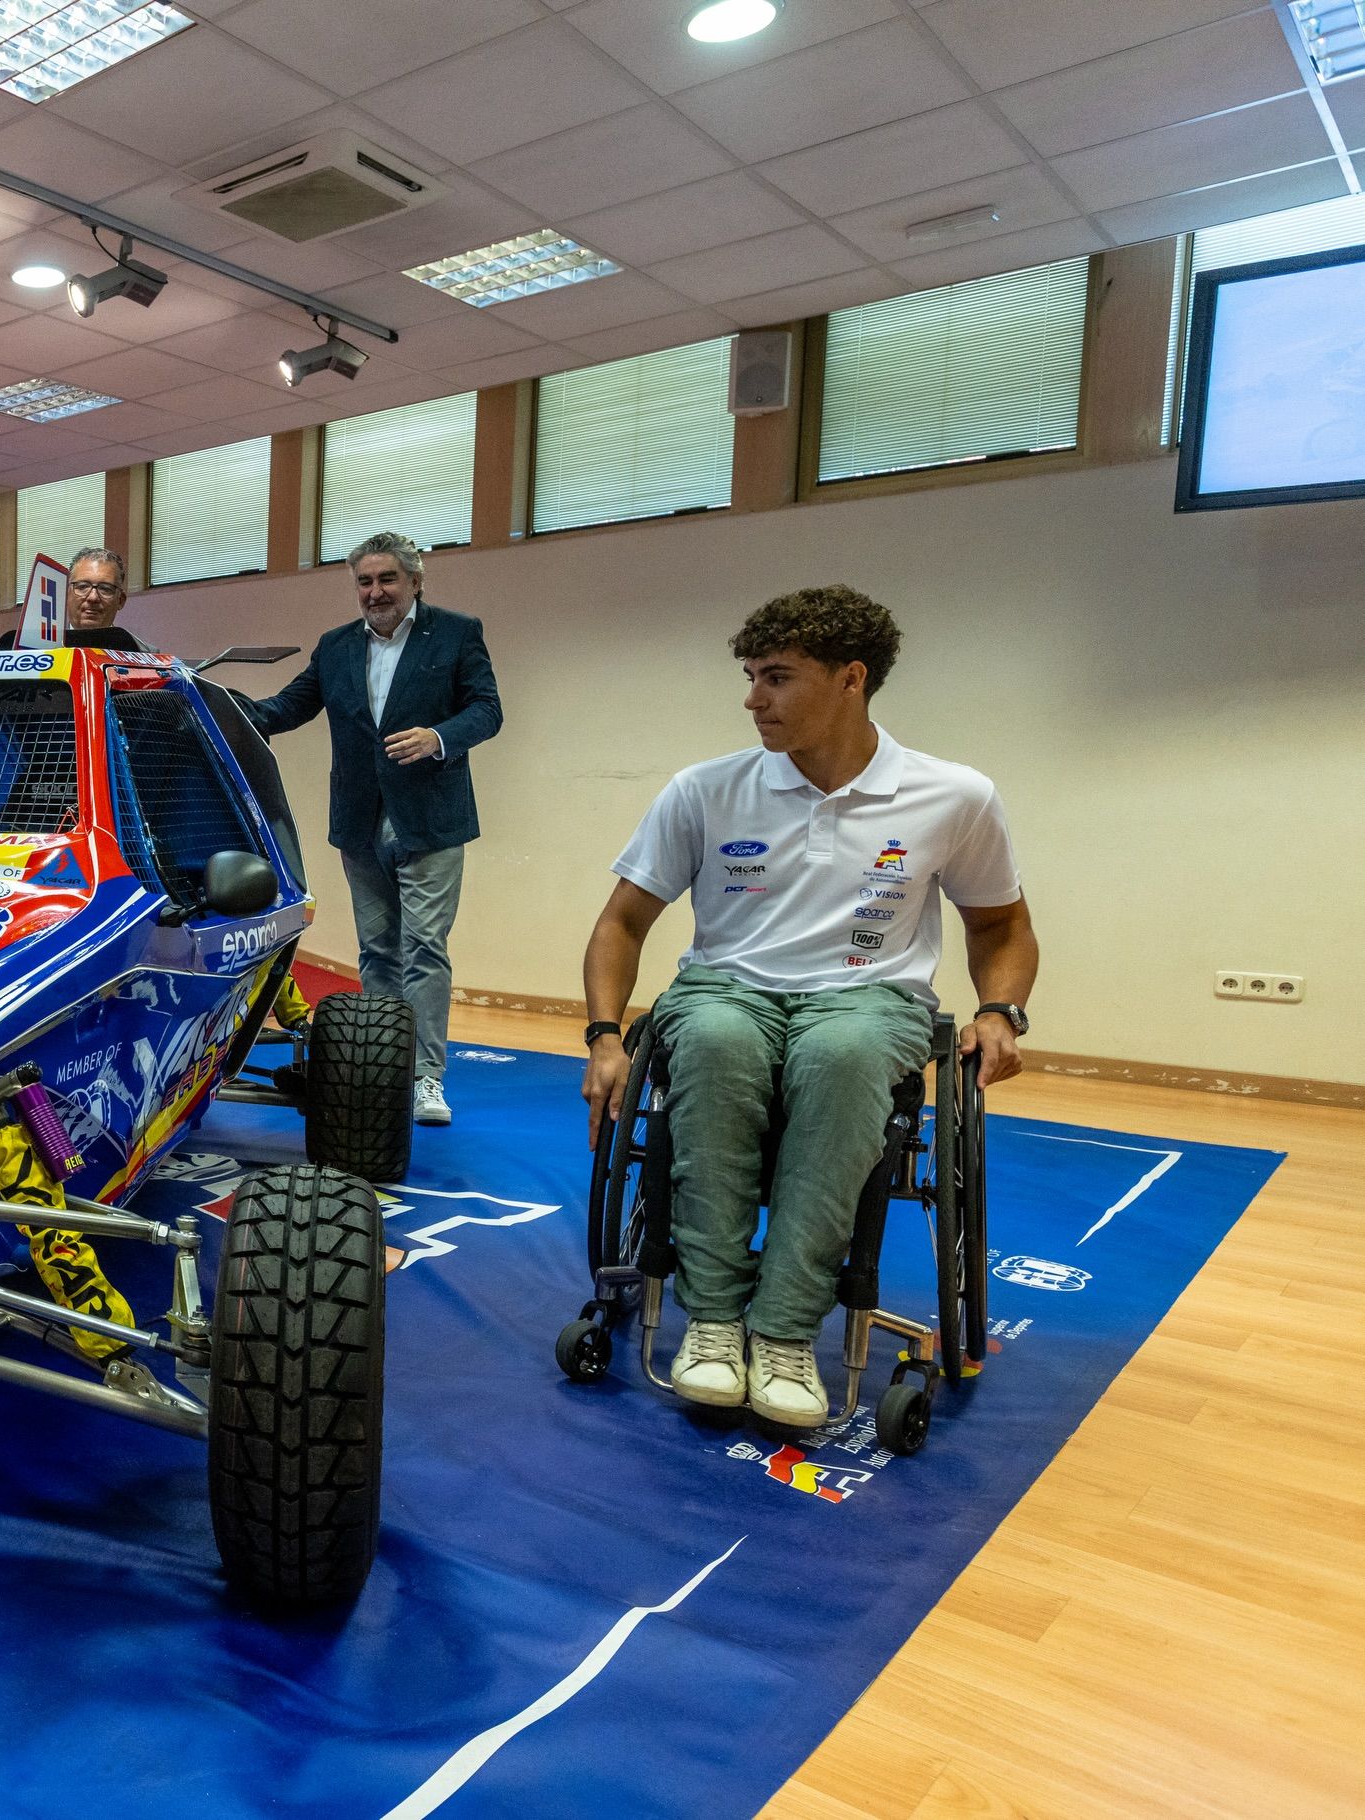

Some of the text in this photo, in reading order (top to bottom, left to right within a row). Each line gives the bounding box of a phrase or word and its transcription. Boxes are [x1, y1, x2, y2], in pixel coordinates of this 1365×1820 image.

[729, 843, 759, 855] Ford
[3, 867, 22, 878] OF
[724, 865, 766, 876] YACAR
[875, 889, 906, 900] VISION
[855, 907, 894, 919] sparco
[222, 920, 278, 971] sparco
[56, 1042, 123, 1085] MEMBER OF
